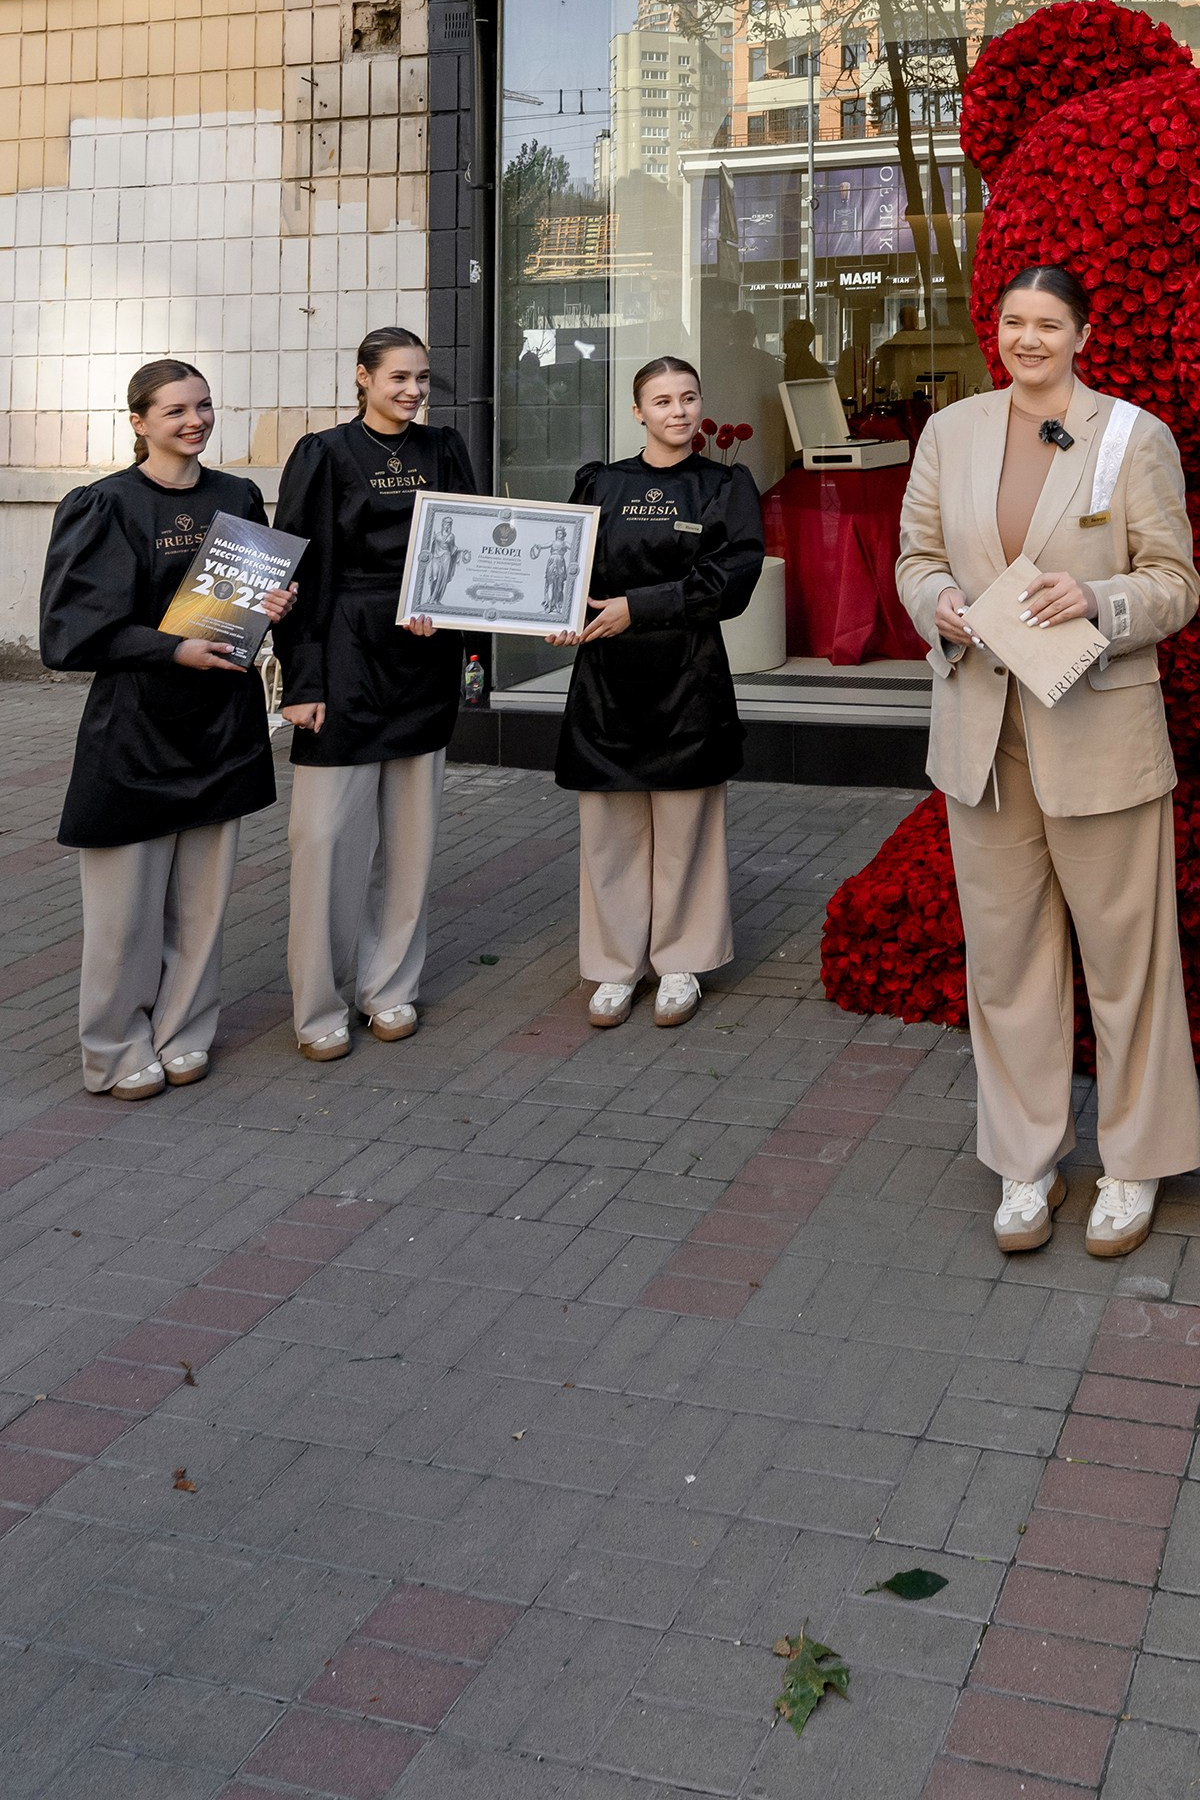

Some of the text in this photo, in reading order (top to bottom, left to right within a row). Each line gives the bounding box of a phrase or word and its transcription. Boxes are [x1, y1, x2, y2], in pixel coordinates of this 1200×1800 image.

[369, 475, 427, 489] FREESIA
[621, 505, 679, 516] FREESIA
[155, 532, 206, 549] FREES
[214, 537, 292, 568] НАЦІОНАЛЬНИЙ
[481, 546, 521, 557] РЕКОРД
[203, 559, 282, 591] УКРАЇНИ
[243, 558, 286, 577] РЕКОРДІВ
[1047, 641, 1106, 703] FREESIA
